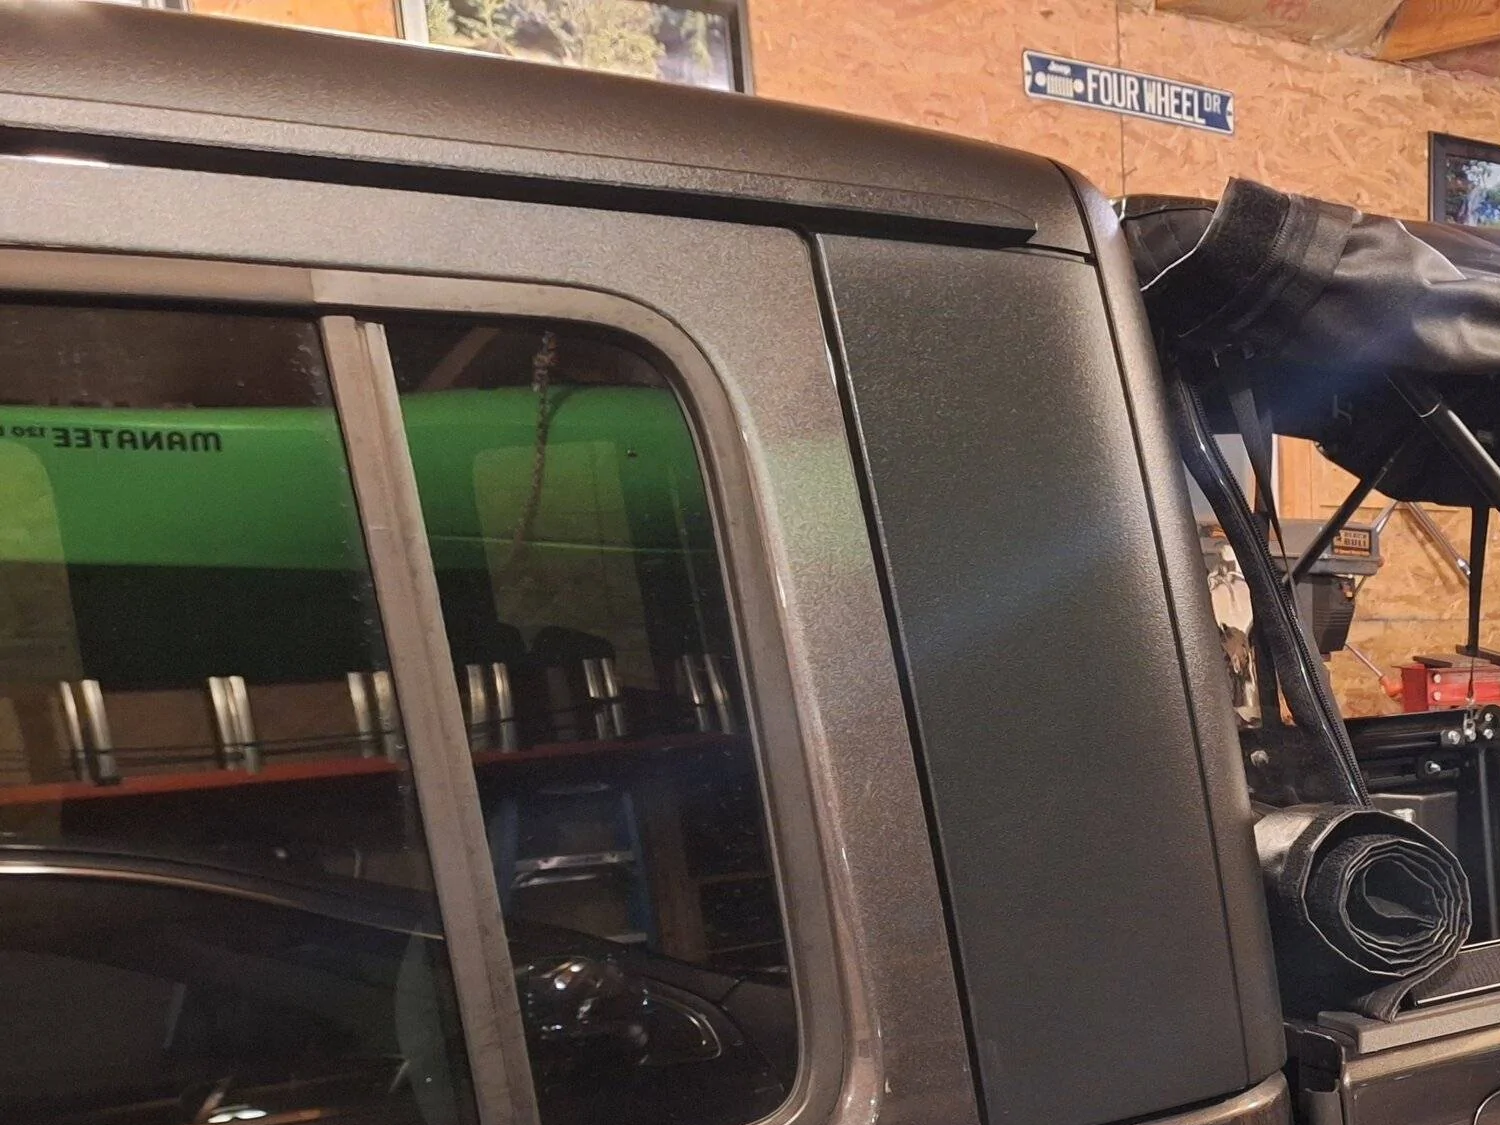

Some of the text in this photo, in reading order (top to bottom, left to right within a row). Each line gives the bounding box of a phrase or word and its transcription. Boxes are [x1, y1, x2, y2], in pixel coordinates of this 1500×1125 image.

[1086, 68, 1221, 125] FOUR WHEEL DR
